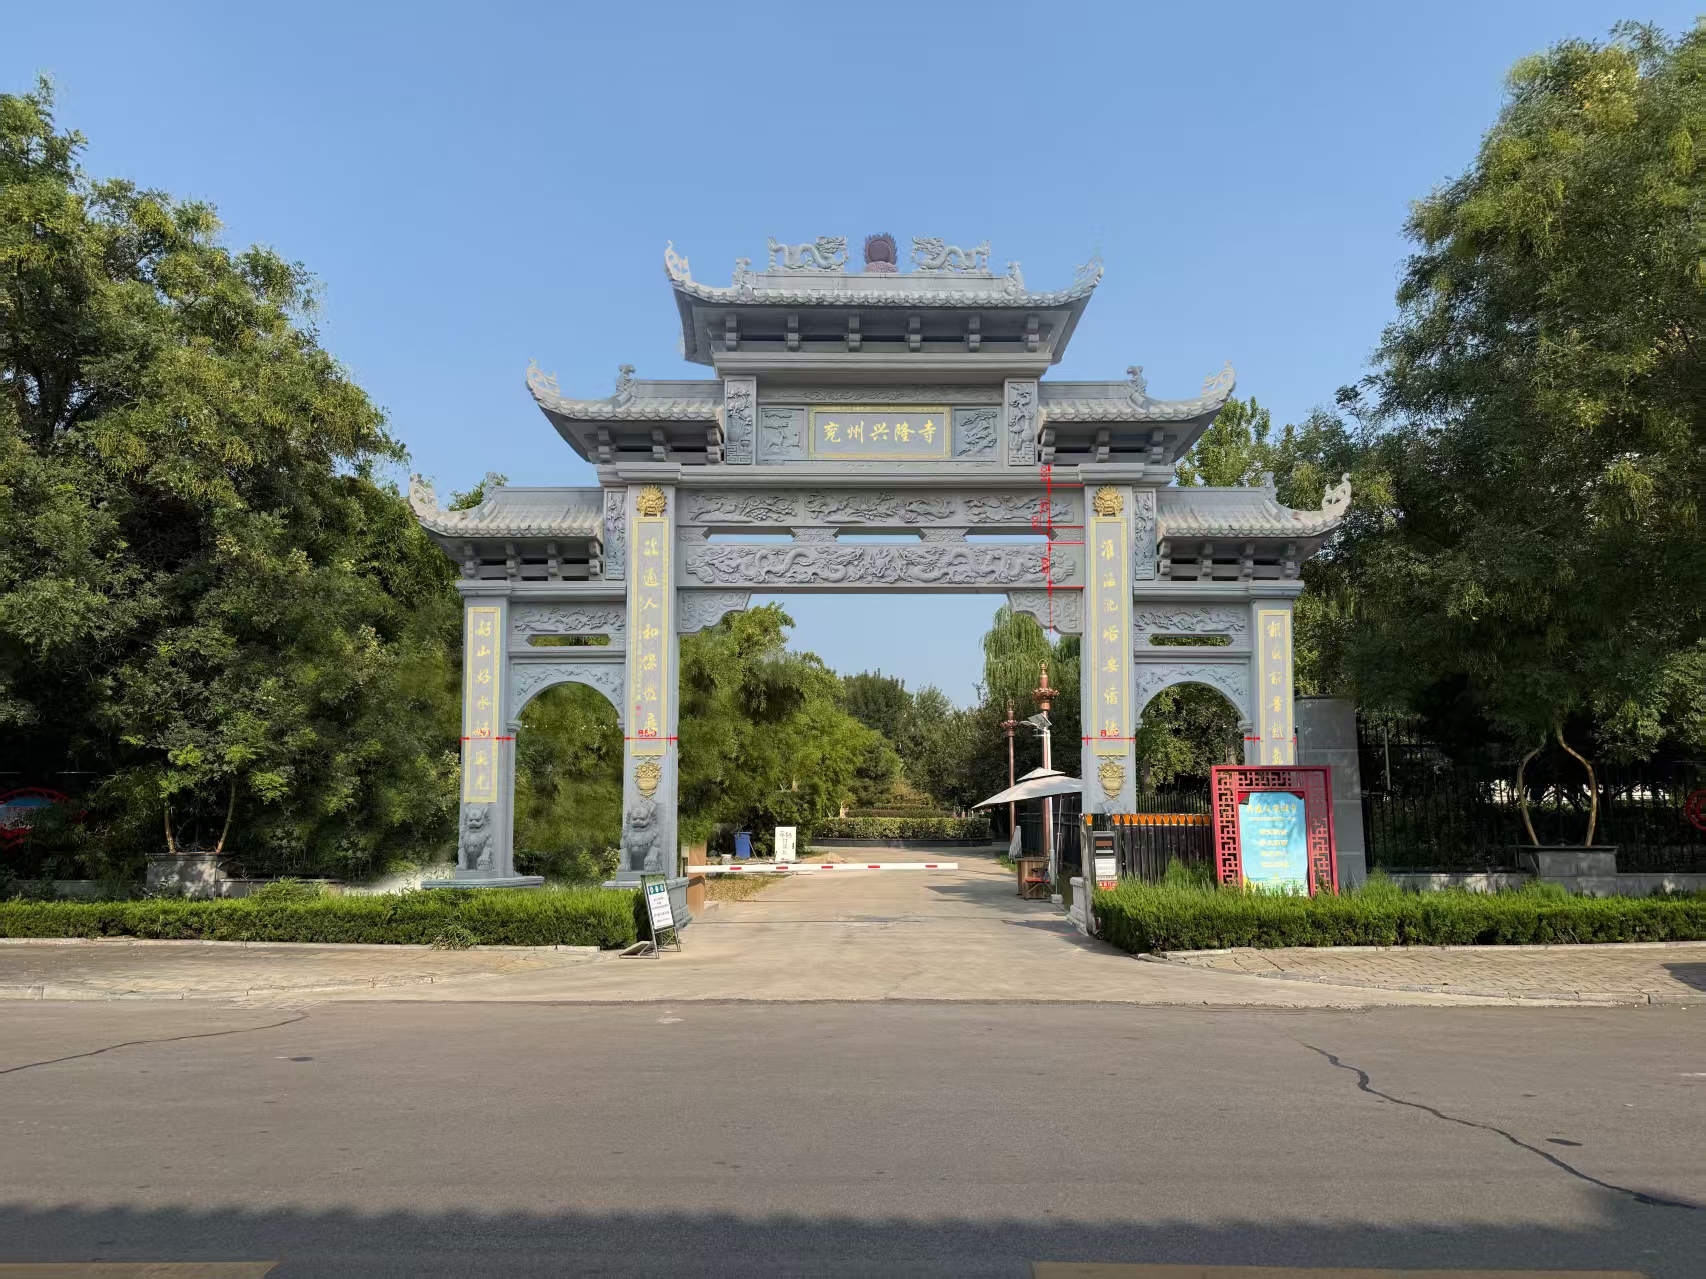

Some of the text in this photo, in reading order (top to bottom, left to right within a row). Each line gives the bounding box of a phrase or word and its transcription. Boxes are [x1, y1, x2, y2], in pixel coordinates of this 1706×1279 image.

[823, 421, 936, 444] 兖州兴隆寺
